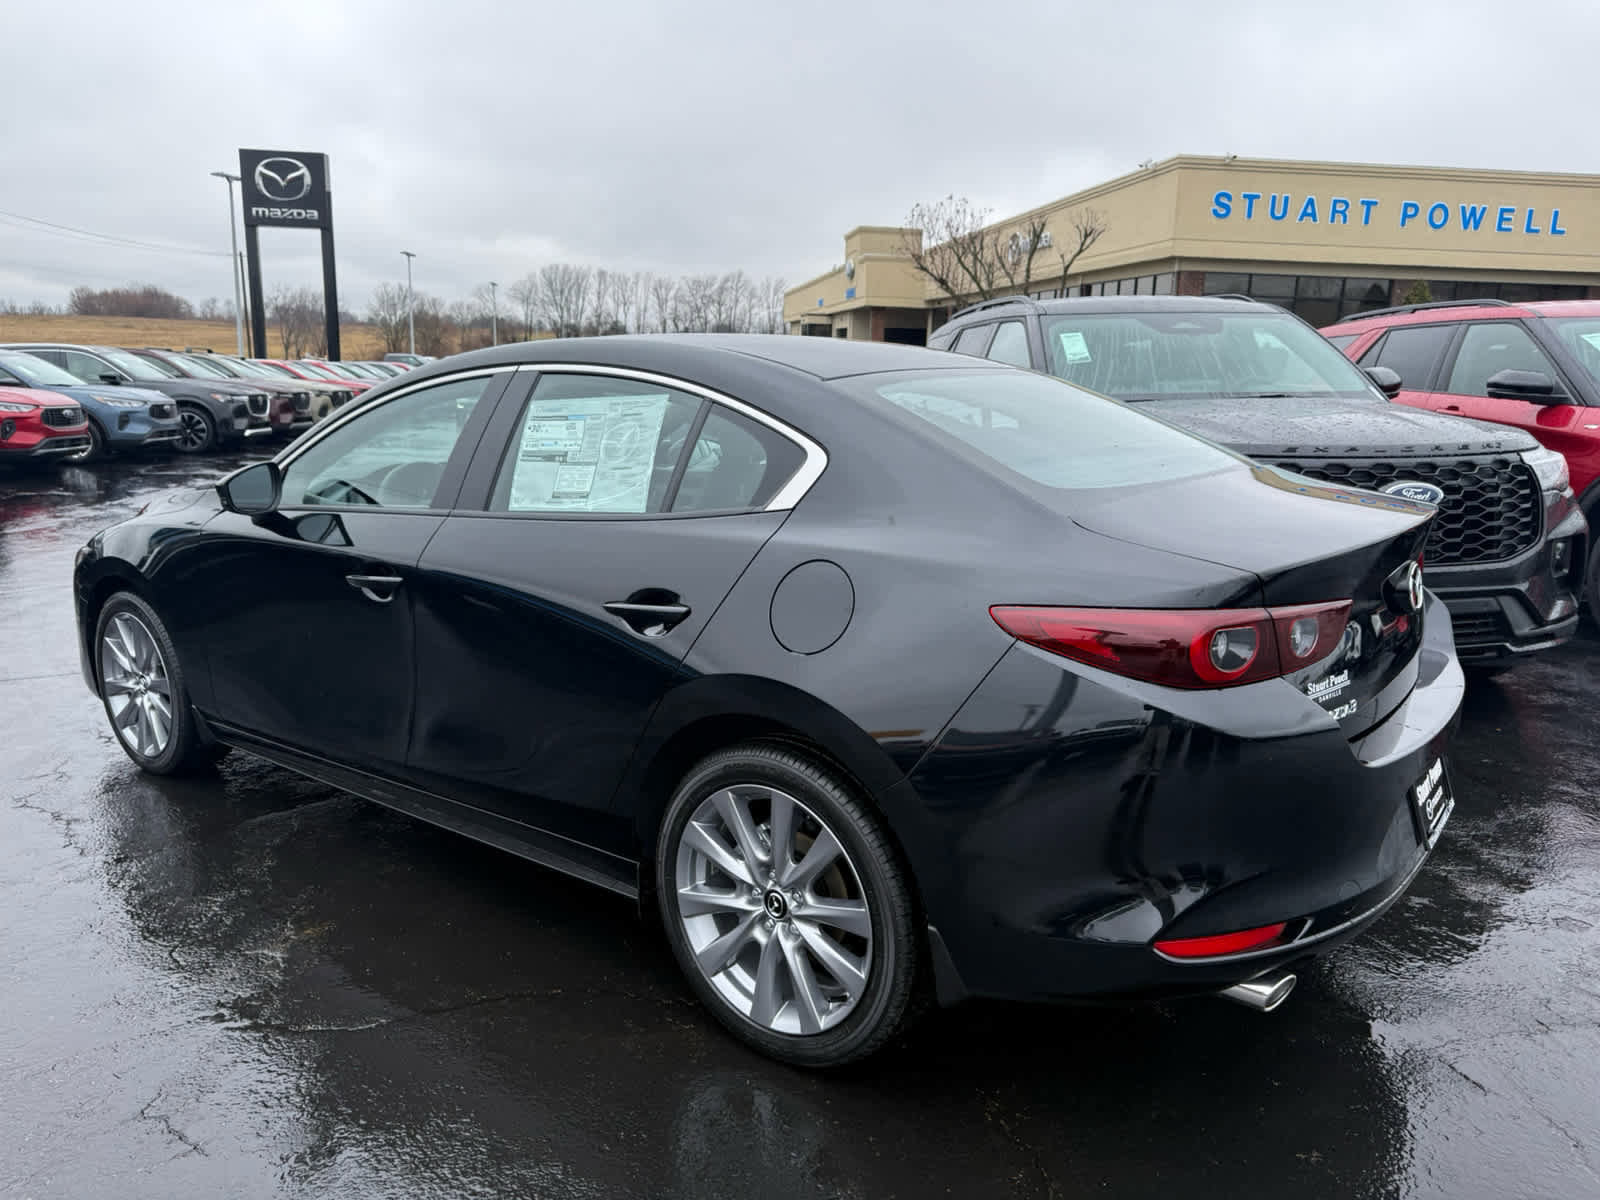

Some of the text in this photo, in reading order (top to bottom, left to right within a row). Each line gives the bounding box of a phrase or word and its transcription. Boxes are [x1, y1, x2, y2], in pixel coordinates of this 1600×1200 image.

[251, 207, 319, 220] mazda
[1211, 190, 1567, 236] STUART POWELL
[1402, 487, 1431, 501] Ford
